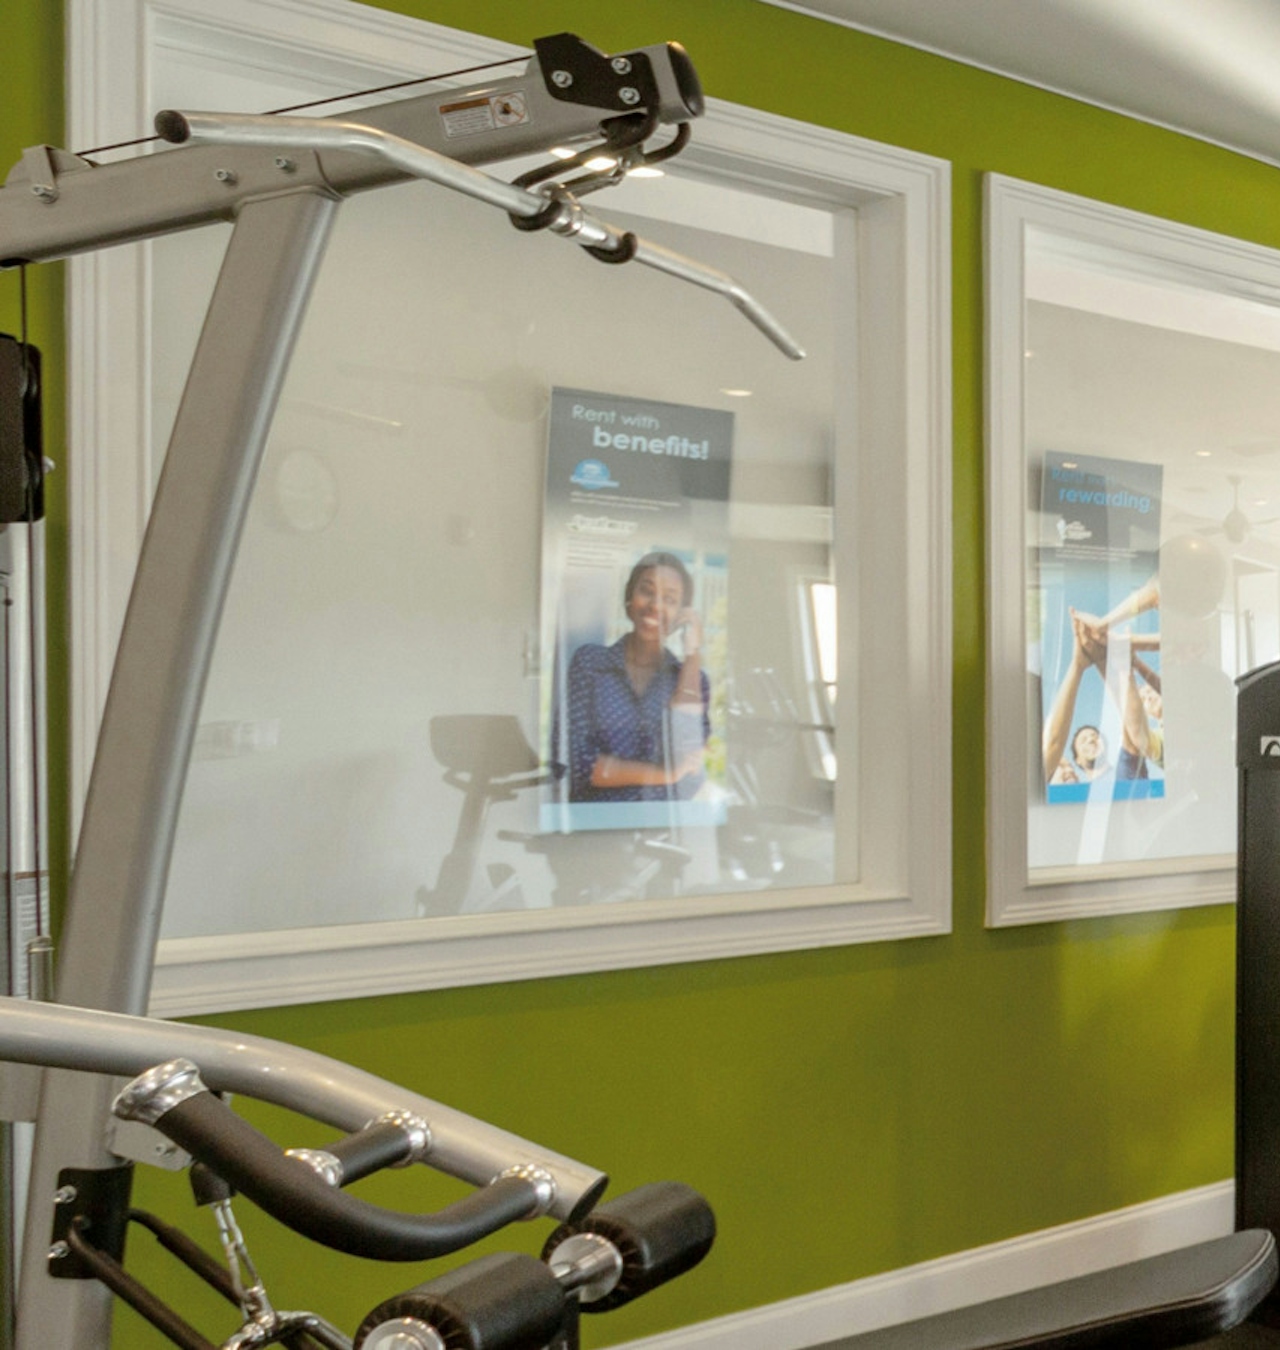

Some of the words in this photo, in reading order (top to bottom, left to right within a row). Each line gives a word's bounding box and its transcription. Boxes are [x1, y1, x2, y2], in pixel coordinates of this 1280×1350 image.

[572, 404, 616, 423] Rent
[620, 412, 660, 430] with
[593, 426, 709, 460] benefits!
